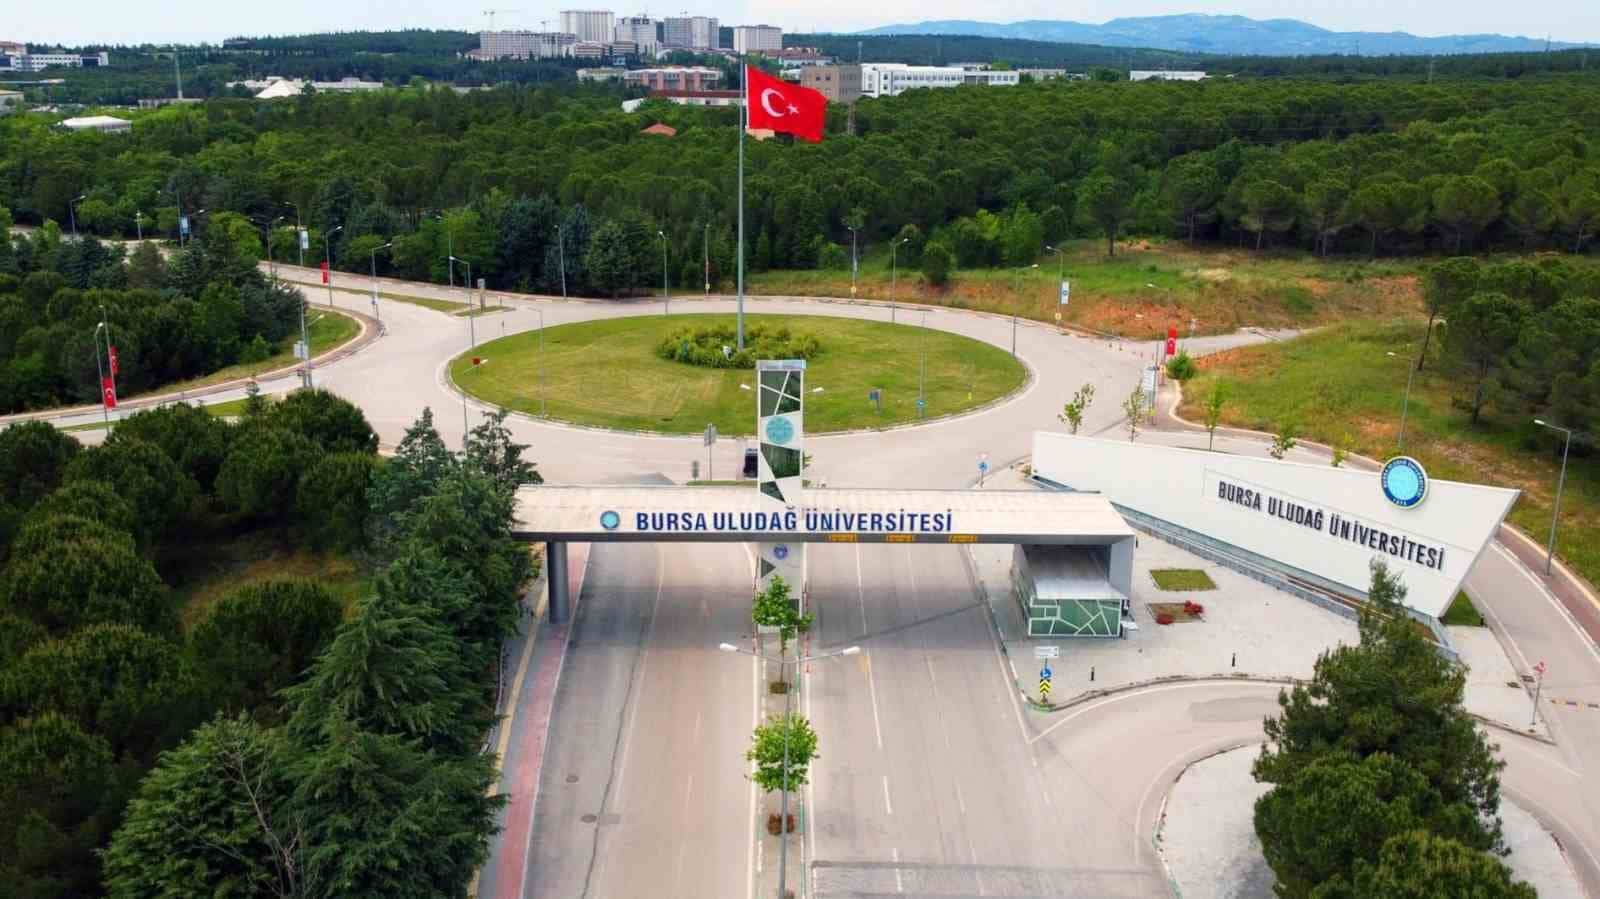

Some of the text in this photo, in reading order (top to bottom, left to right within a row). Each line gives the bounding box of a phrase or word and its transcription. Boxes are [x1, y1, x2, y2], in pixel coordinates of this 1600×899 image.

[636, 505, 952, 531] BURSA ULUDAĞ ÜNİVERSİTESİ
[1218, 480, 1444, 570] BURSA ULUDAĞ ÜNİVERSİTESİ
